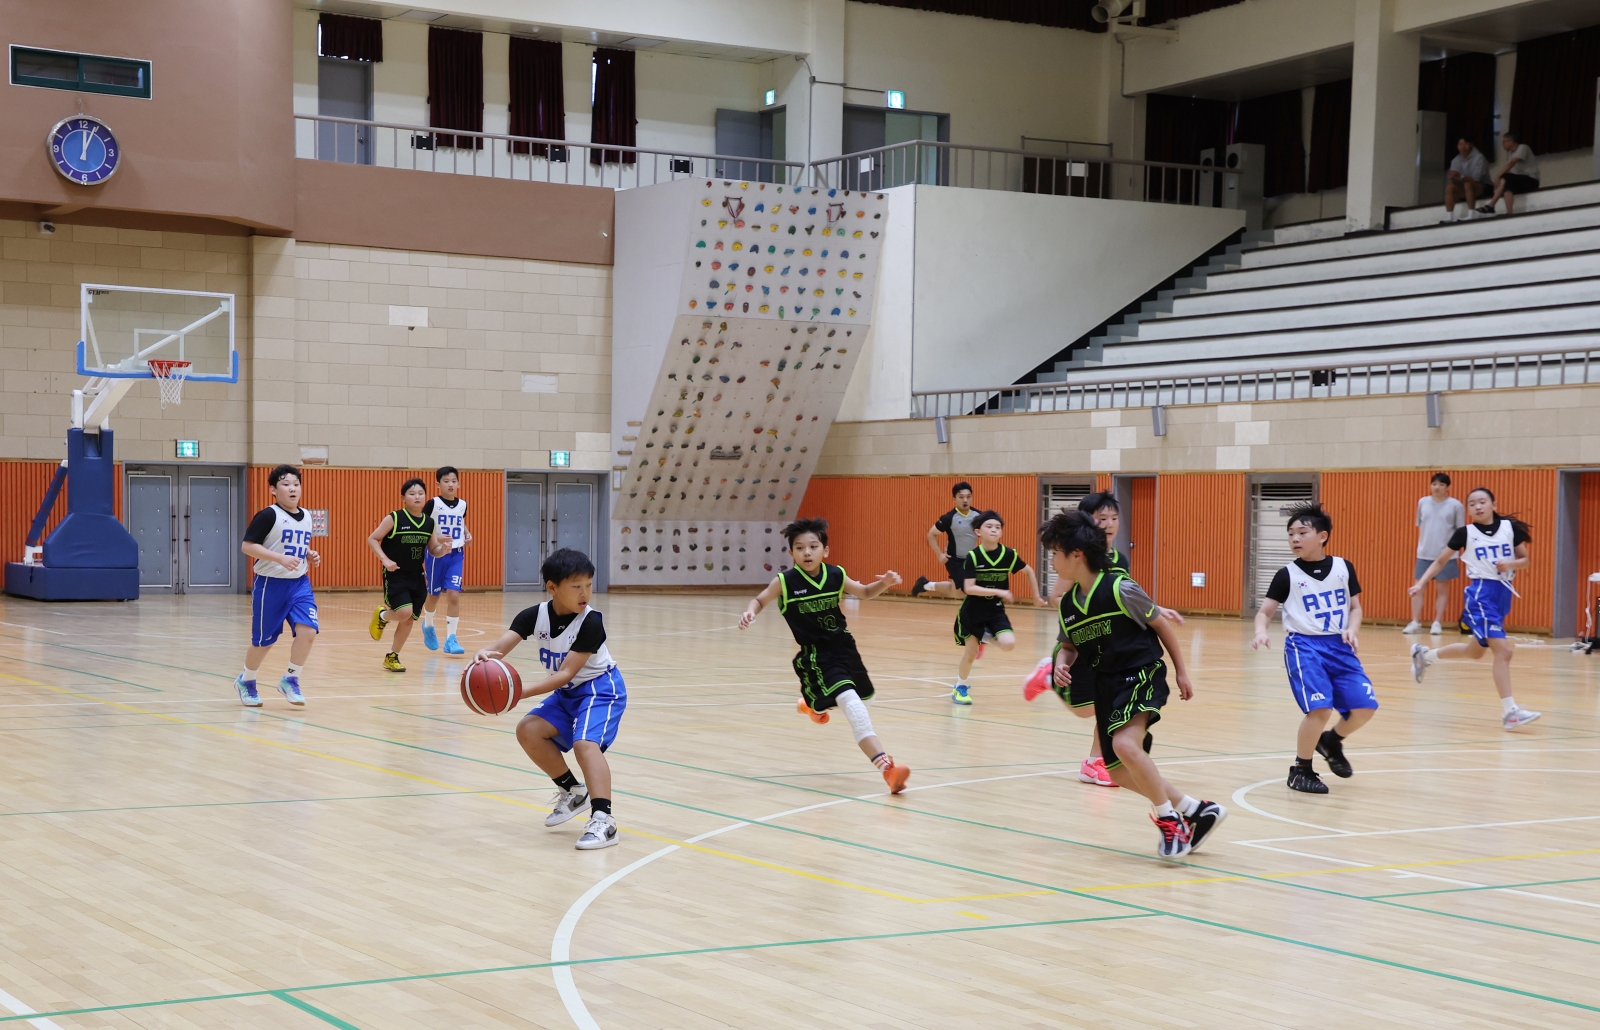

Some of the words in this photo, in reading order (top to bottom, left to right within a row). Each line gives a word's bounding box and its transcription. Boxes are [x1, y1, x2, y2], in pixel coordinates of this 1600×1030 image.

[79, 120, 88, 129] 12
[53, 144, 60, 153] 9
[108, 148, 115, 157] 3
[81, 173, 88, 182] 6
[1302, 588, 1347, 612] ATB
[1314, 609, 1344, 632] 77
